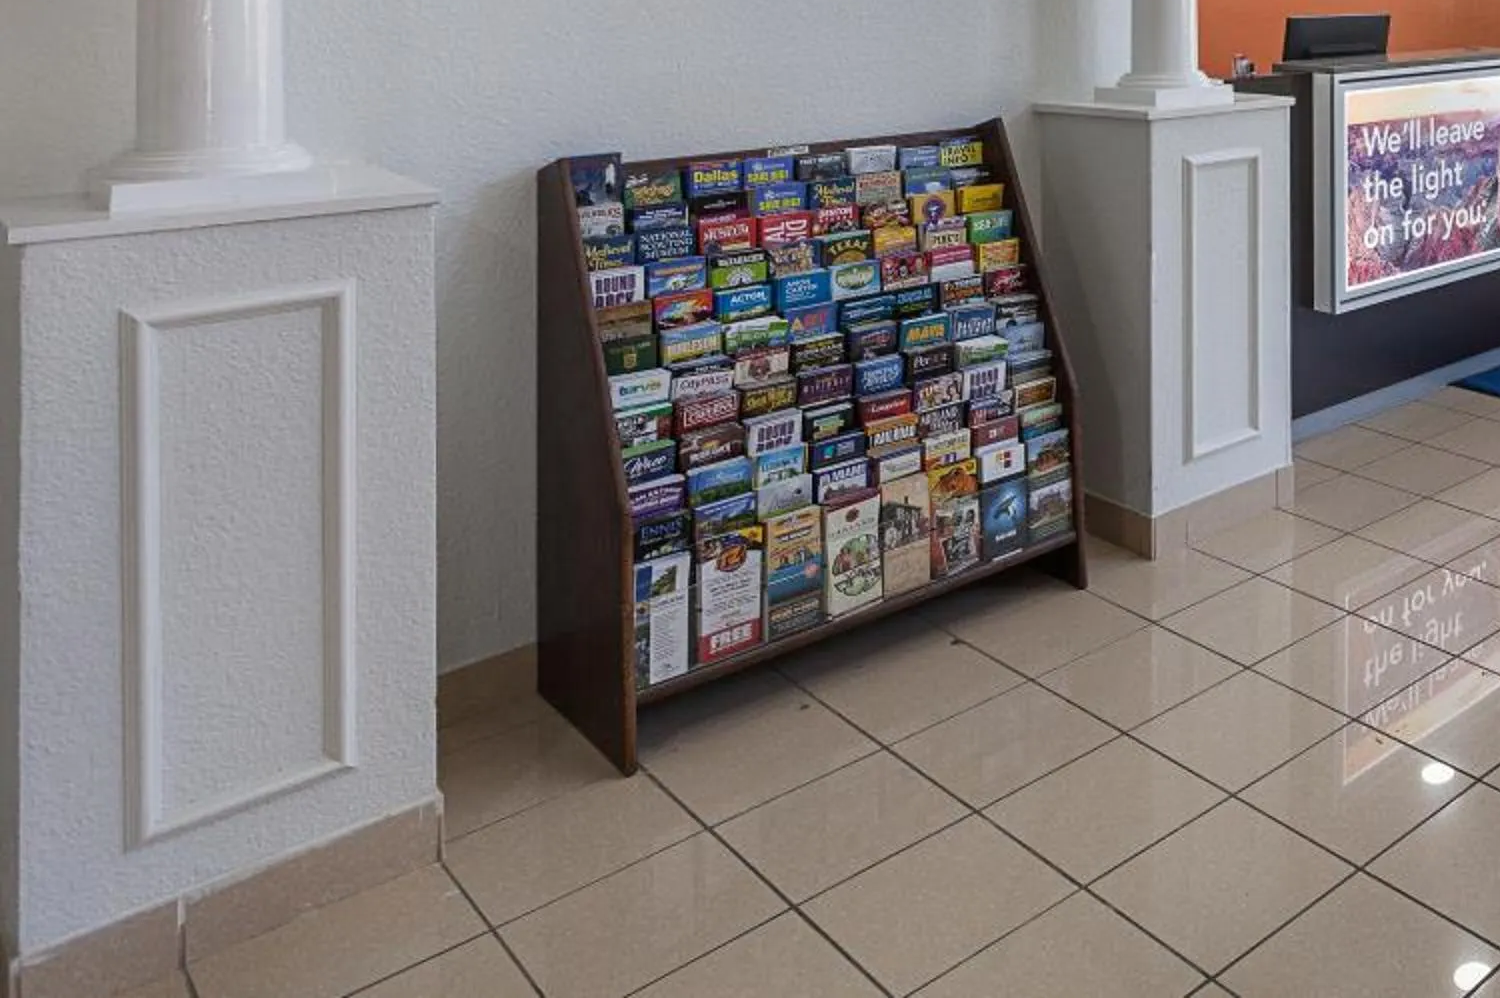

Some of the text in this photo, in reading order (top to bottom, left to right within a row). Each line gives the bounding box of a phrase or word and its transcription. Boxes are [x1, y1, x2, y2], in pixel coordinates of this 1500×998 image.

[1362, 117, 1485, 157] We'll leave
[693, 169, 738, 184] Dallas
[1362, 159, 1464, 203] the light
[1363, 223, 1394, 249] on
[1402, 208, 1438, 241] for
[829, 239, 869, 255] TEXAS
[595, 273, 636, 294] ROUND
[709, 623, 753, 654] FREE
